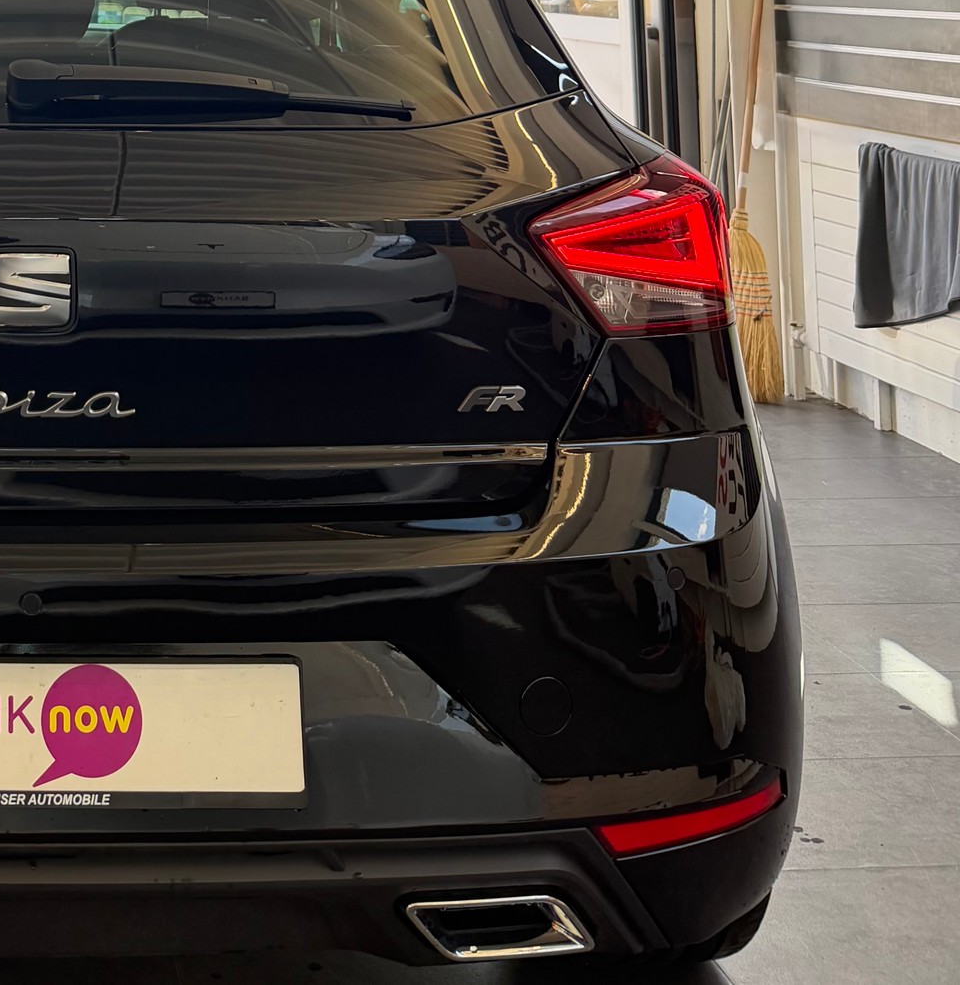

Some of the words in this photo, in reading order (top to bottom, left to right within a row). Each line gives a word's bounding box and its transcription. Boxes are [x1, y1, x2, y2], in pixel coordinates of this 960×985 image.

[457, 385, 527, 412] FR
[49, 705, 134, 734] now
[27, 793, 111, 806] AUTOMOBILE
